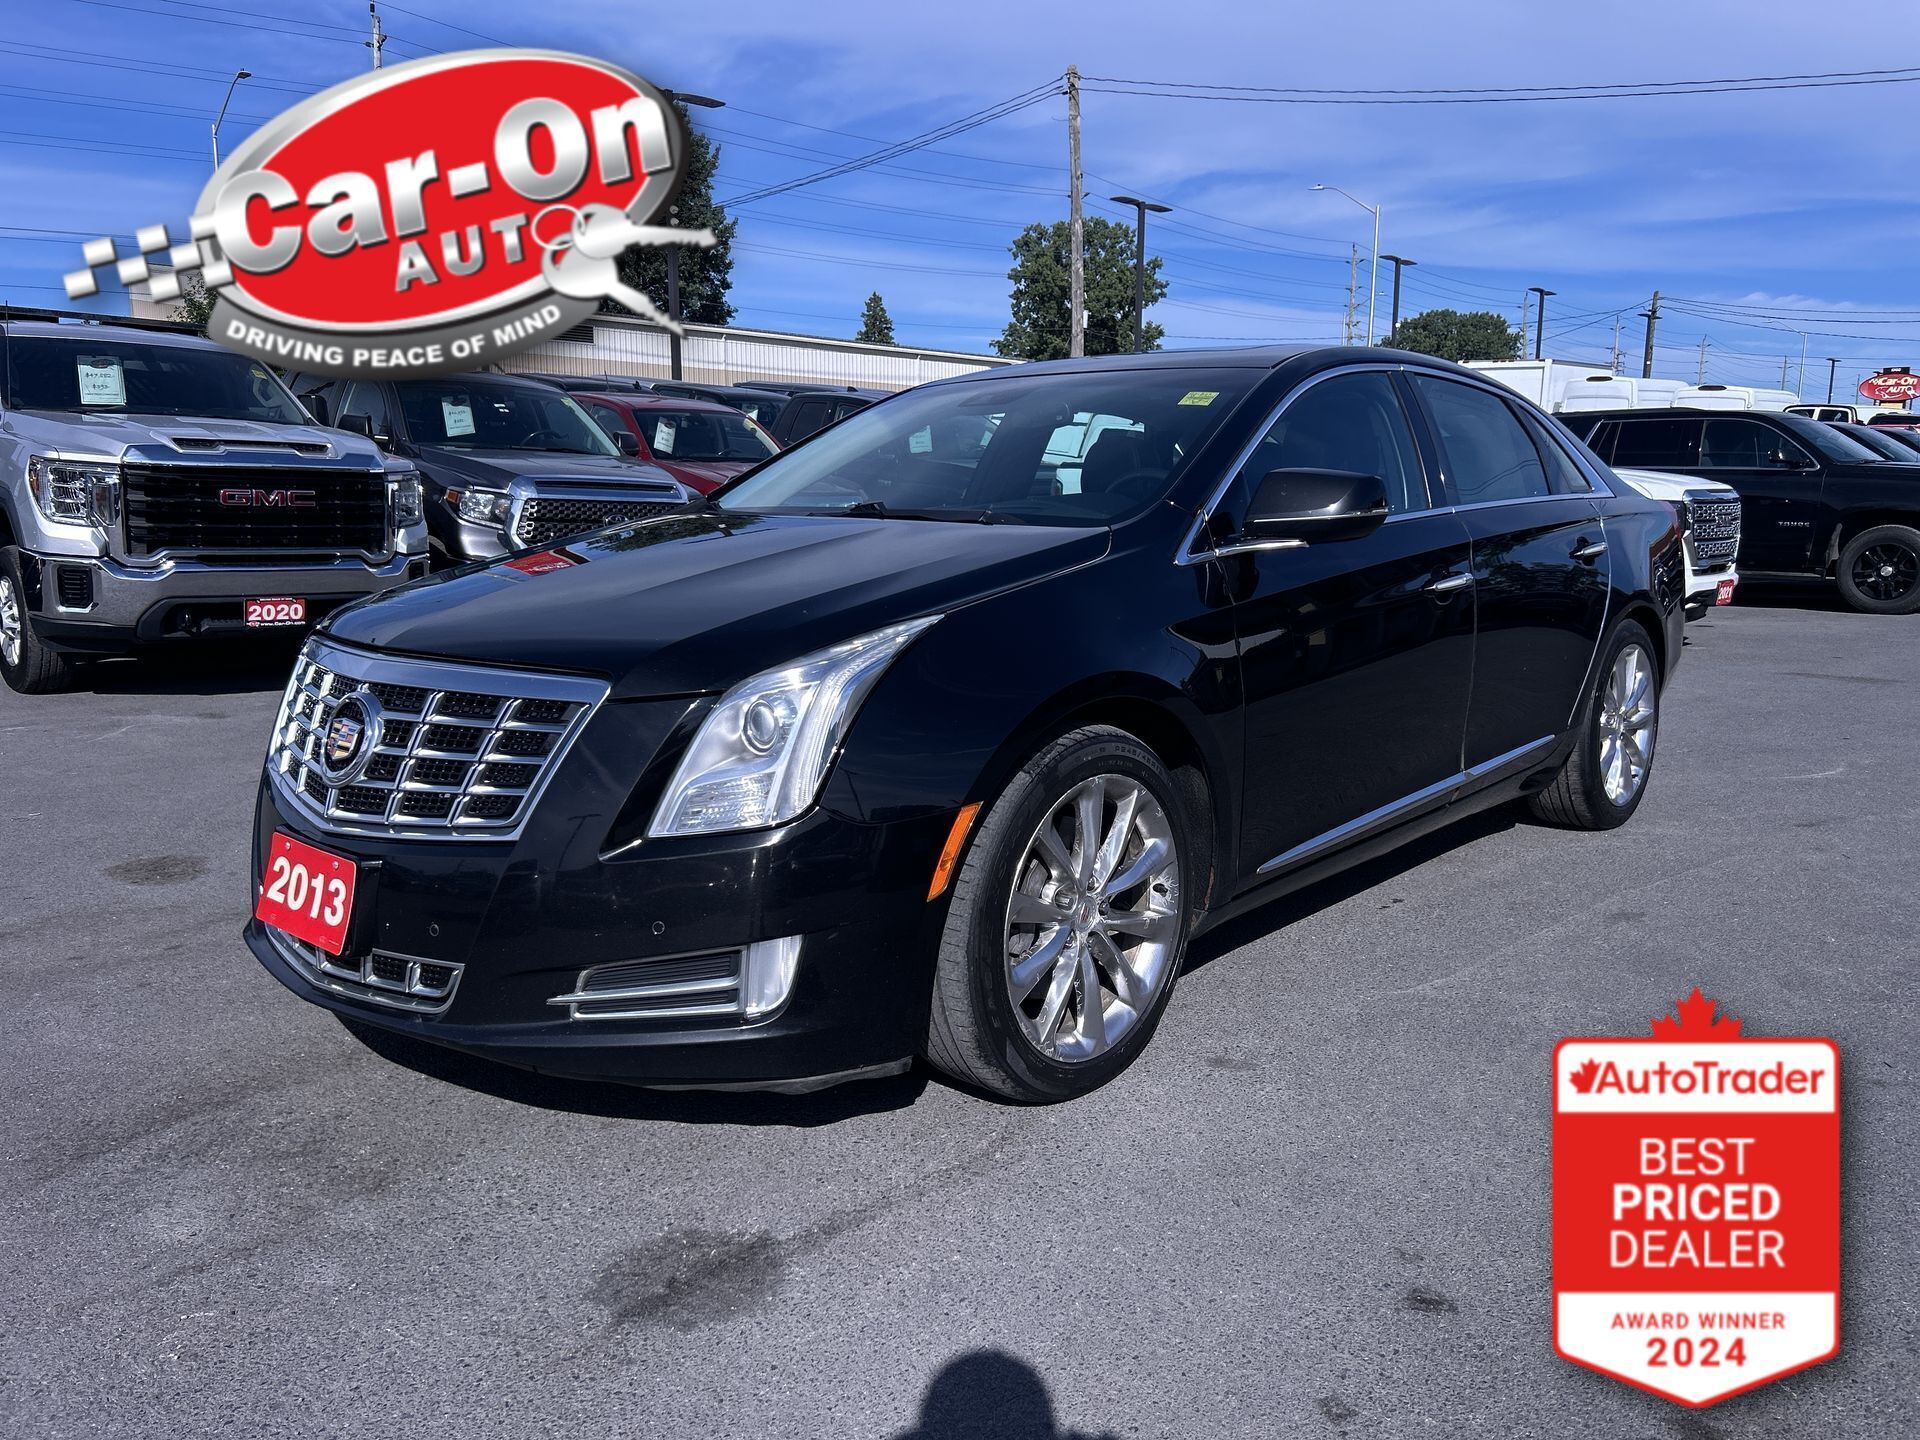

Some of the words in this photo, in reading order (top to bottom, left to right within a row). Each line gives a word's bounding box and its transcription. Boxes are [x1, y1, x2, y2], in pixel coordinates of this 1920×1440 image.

[1879, 376, 1918, 386] Car-On
[220, 488, 316, 507] GMC
[248, 603, 303, 621] 2020
[266, 855, 347, 927] 2013
